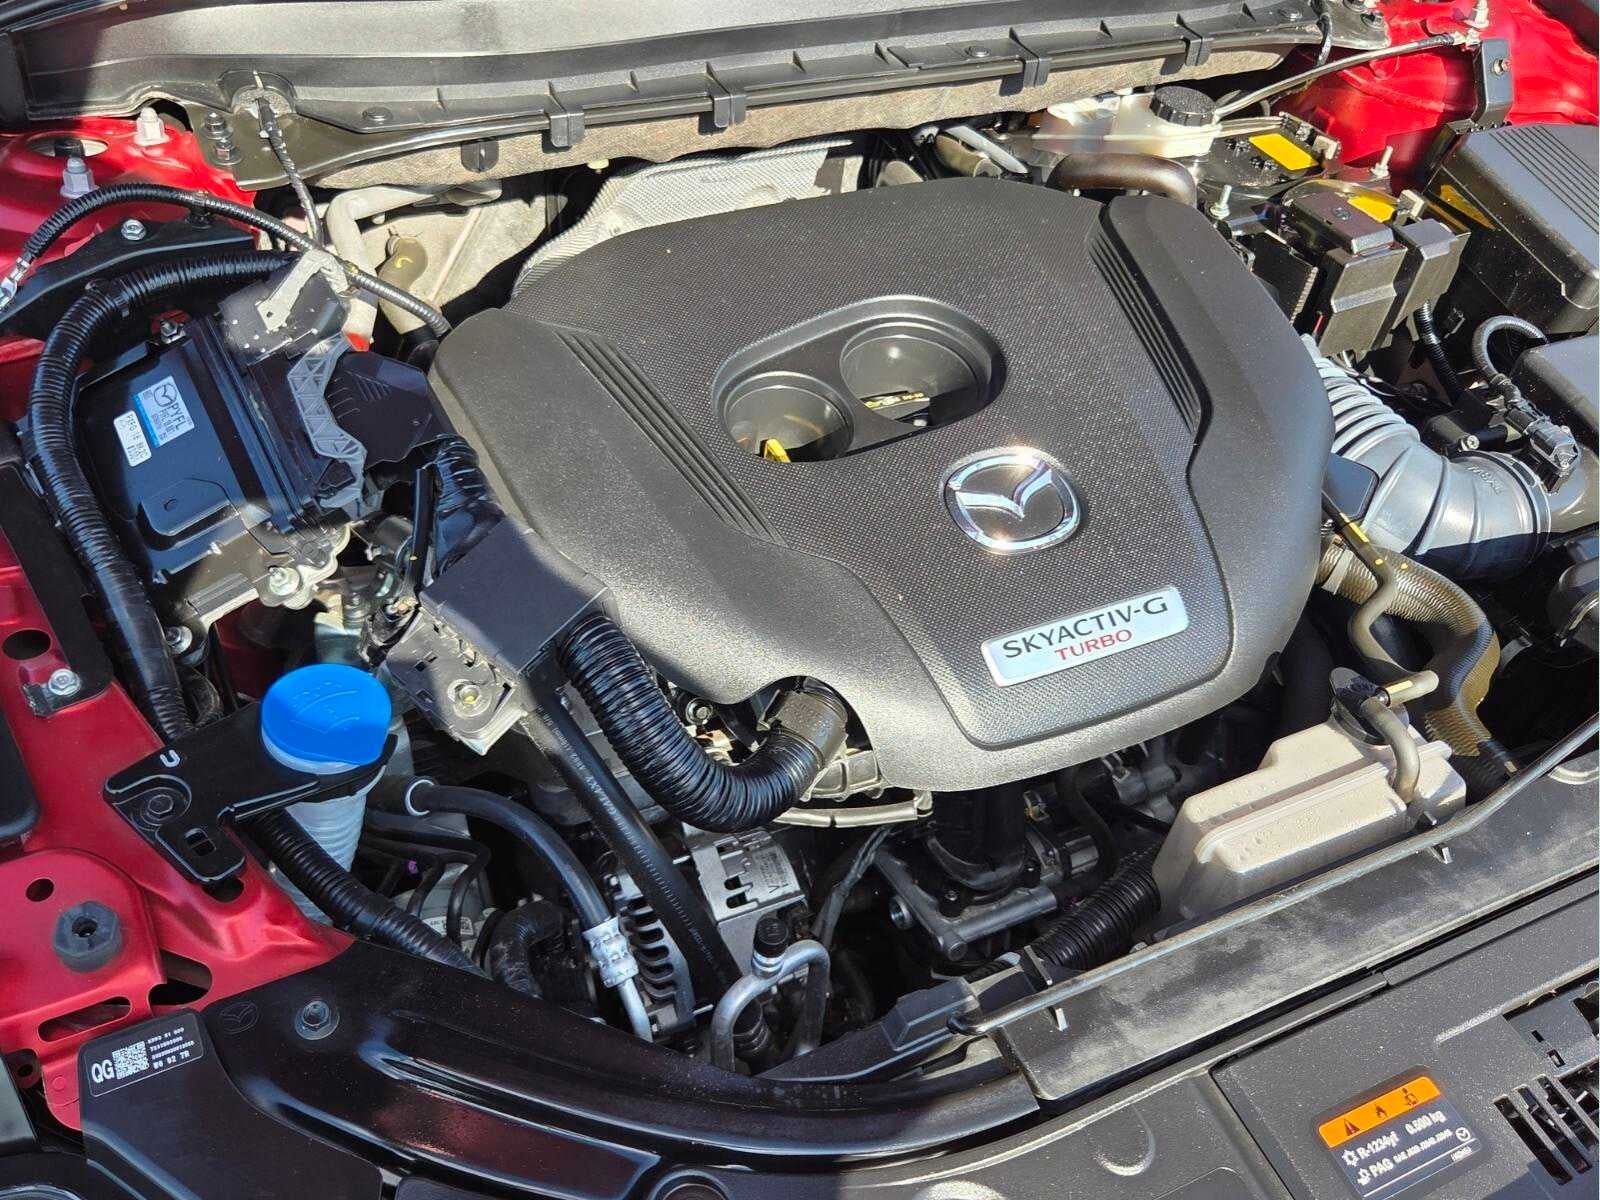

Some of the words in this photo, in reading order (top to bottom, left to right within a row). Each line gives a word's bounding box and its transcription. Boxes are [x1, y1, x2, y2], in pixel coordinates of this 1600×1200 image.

[166, 402, 186, 430] PYFL
[1002, 596, 1168, 658] SKYACTIV-G
[1055, 629, 1133, 661] TURBO
[91, 1059, 115, 1082] QG
[1368, 1158, 1394, 1178] PAG
